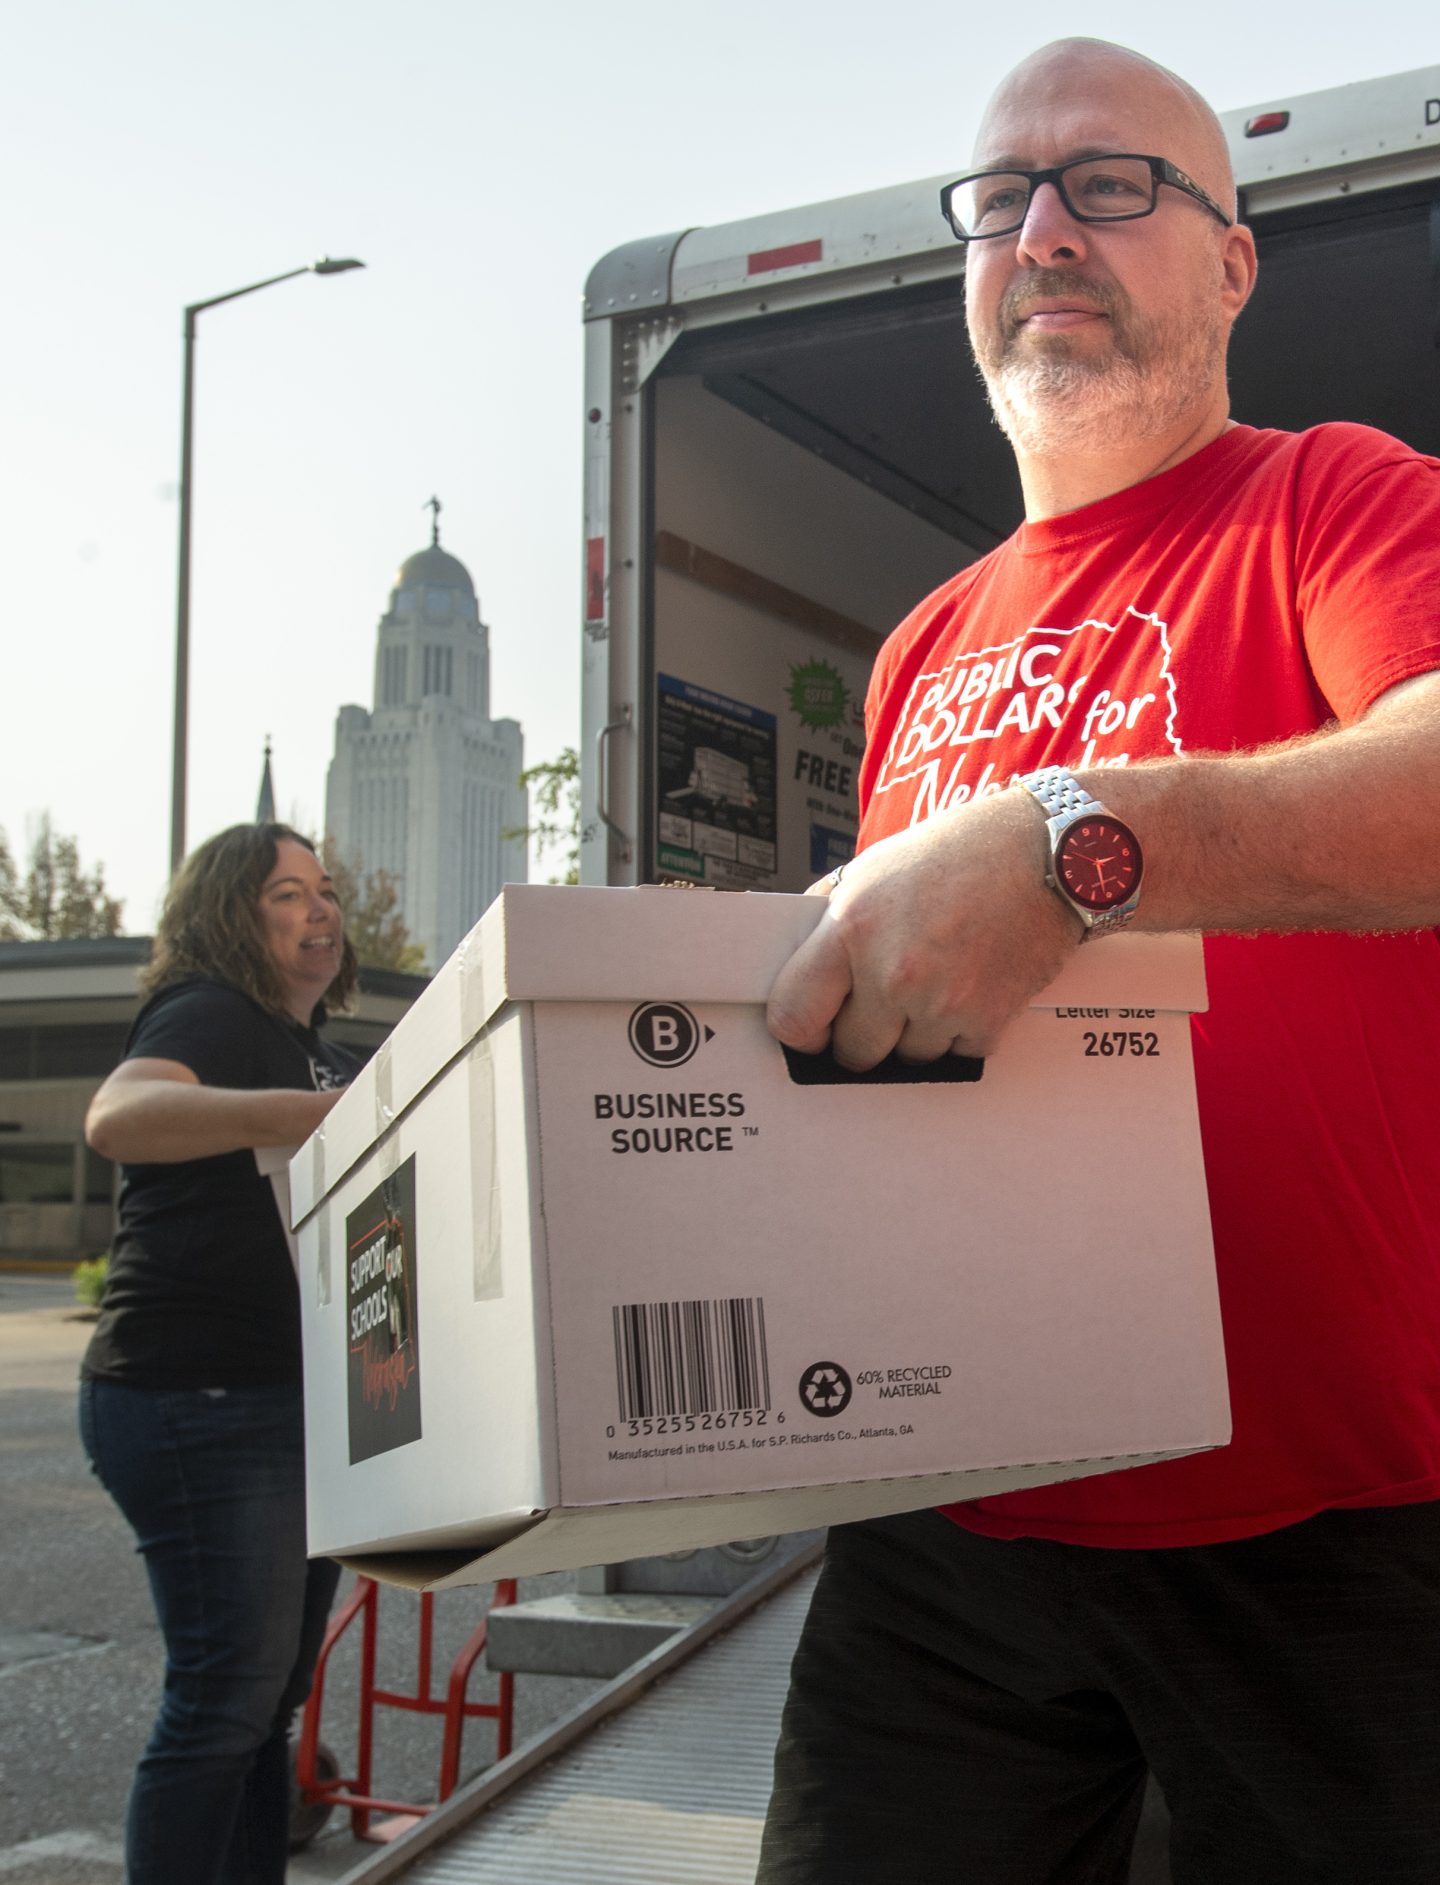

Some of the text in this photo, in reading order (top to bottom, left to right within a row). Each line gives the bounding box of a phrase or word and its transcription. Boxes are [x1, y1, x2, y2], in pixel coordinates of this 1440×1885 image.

[911, 644, 1063, 726] PUBLIC
[1080, 689, 1156, 742] for
[794, 749, 852, 798] FREE
[652, 1015, 679, 1052] B
[1083, 1031, 1160, 1057] 26752
[594, 1092, 746, 1120] BUSINESS
[611, 1126, 734, 1154] SOURCE
[351, 1235, 403, 1294] SUPPORT OUR
[351, 1285, 388, 1341] SCHOOLS
[856, 1365, 952, 1386] 60% RECYCLED
[878, 1382, 942, 1399] MATERIAL
[606, 1425, 616, 1438] 0
[777, 1411, 786, 1424] 6
[608, 1424, 915, 1461] Manufactured in the U.S.A. for S.P. Richards Co., Atlanta, GA
